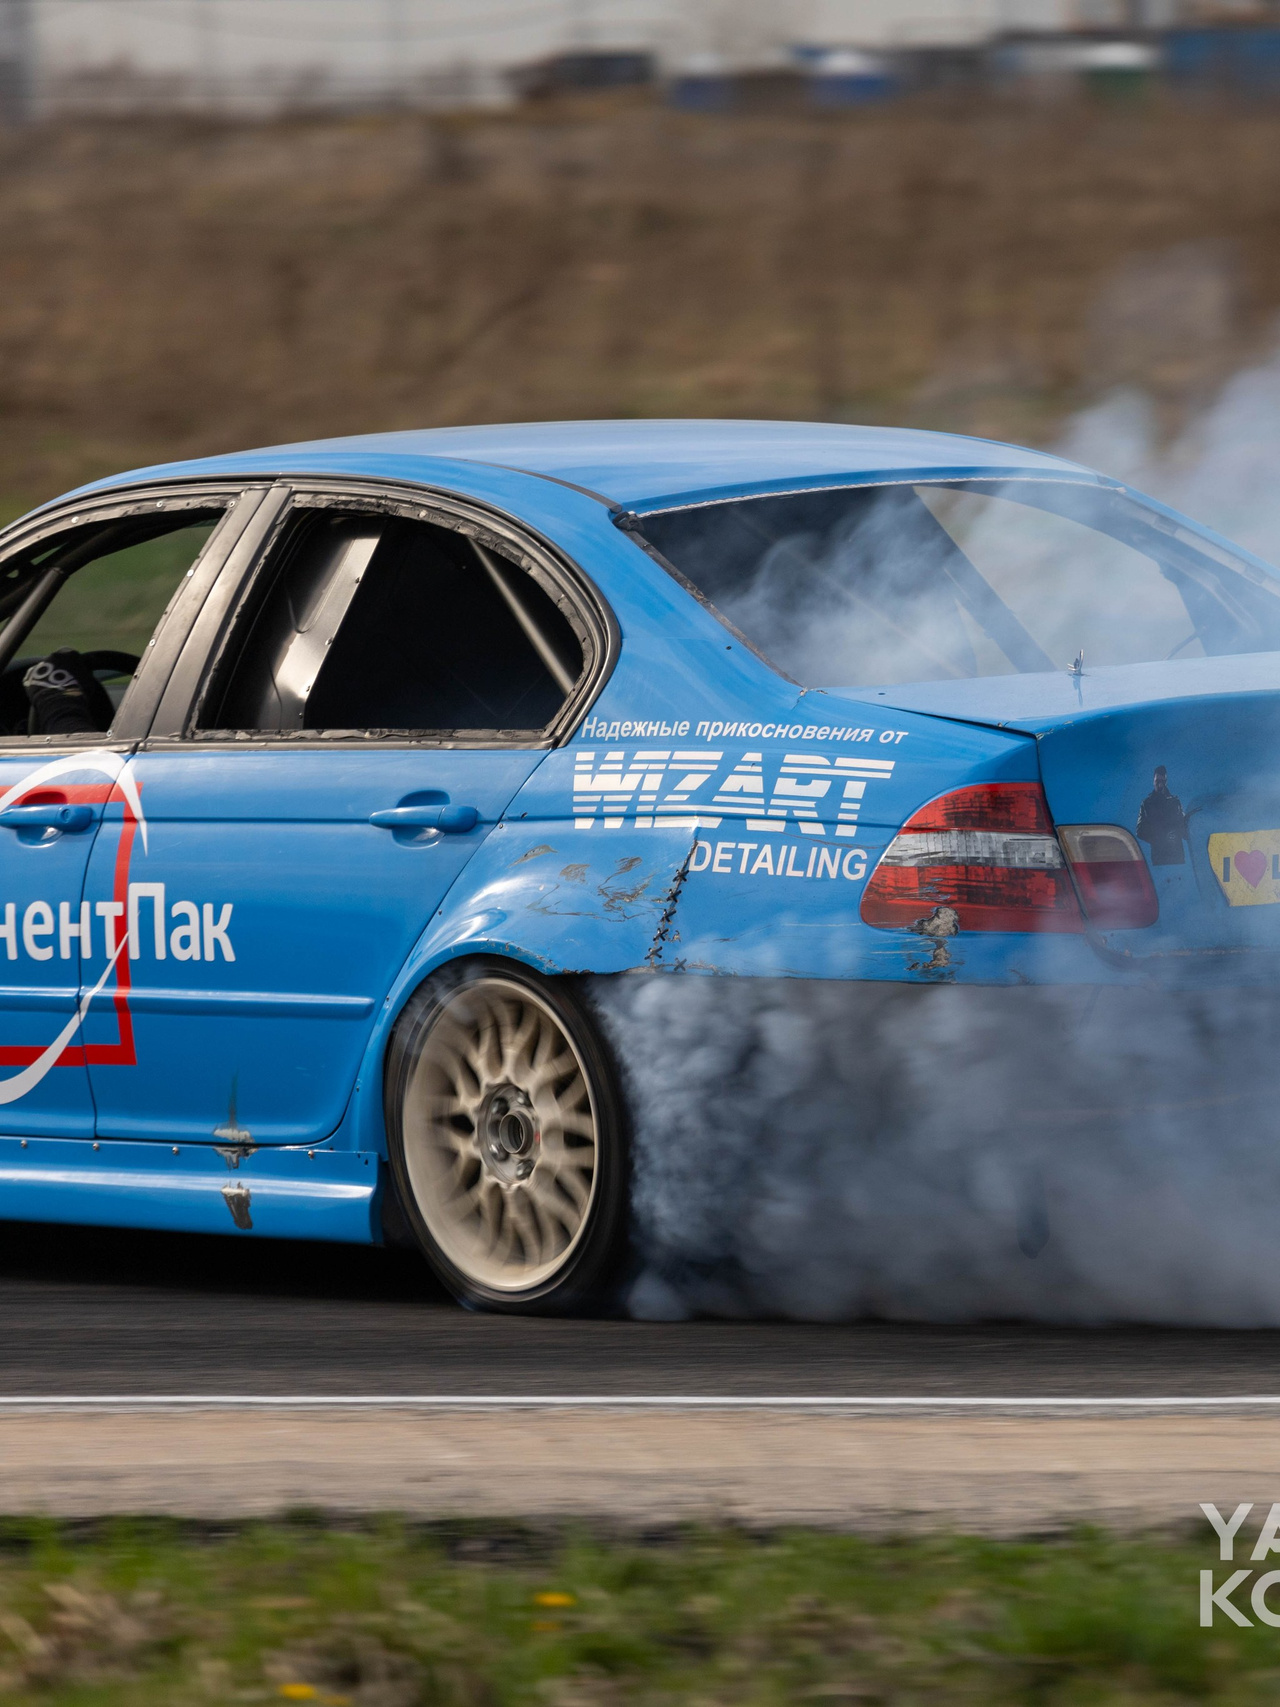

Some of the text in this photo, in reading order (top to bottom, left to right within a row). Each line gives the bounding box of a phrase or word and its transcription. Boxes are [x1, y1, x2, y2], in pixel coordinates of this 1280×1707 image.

[582, 717, 908, 745] Надежные прикосновения от
[573, 751, 895, 837] WIZART
[689, 841, 867, 880] DETAILING
[1223, 856, 1231, 882] I
